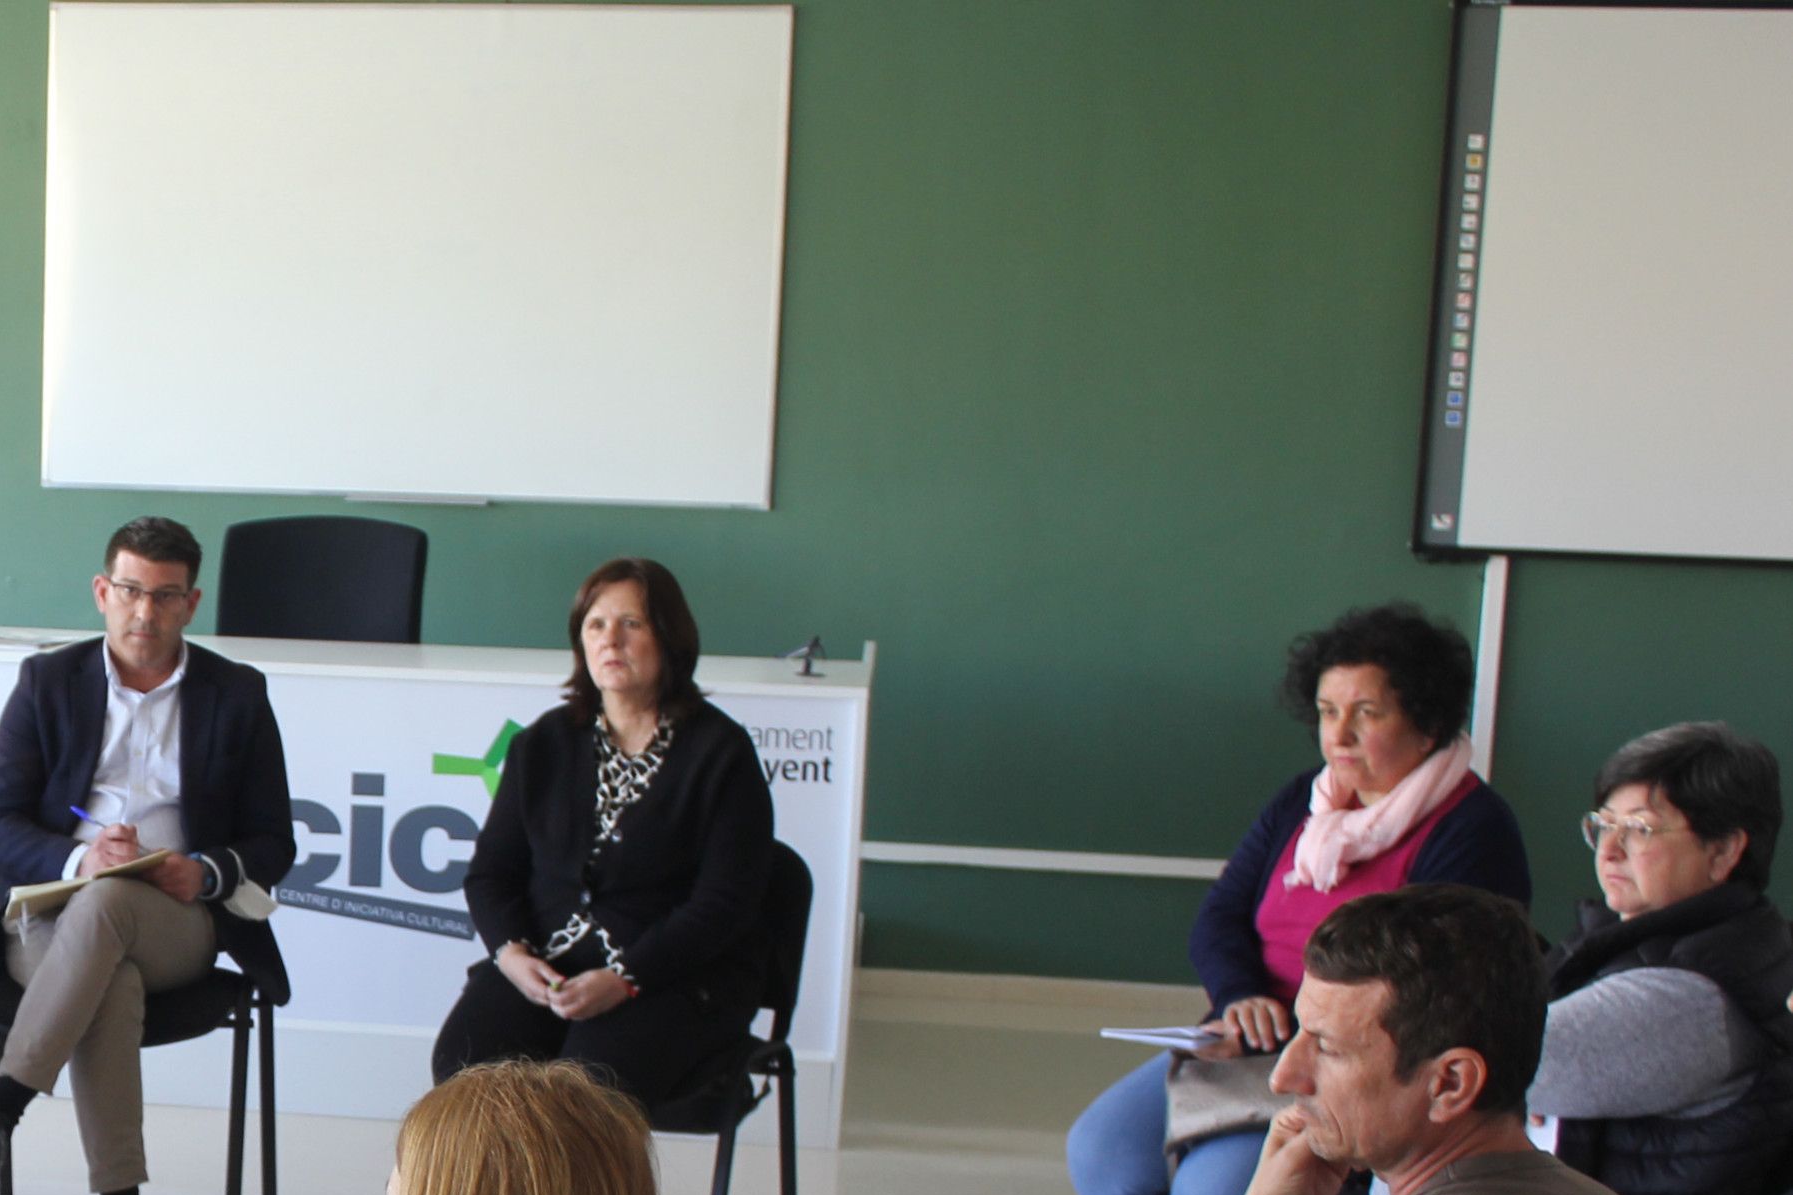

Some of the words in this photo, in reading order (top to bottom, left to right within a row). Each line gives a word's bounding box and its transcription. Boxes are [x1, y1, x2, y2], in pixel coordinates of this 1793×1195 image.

[750, 726, 832, 751] ament
[764, 756, 832, 785] yent
[279, 888, 329, 908] CENTRE
[408, 912, 470, 933] CULTURAL
